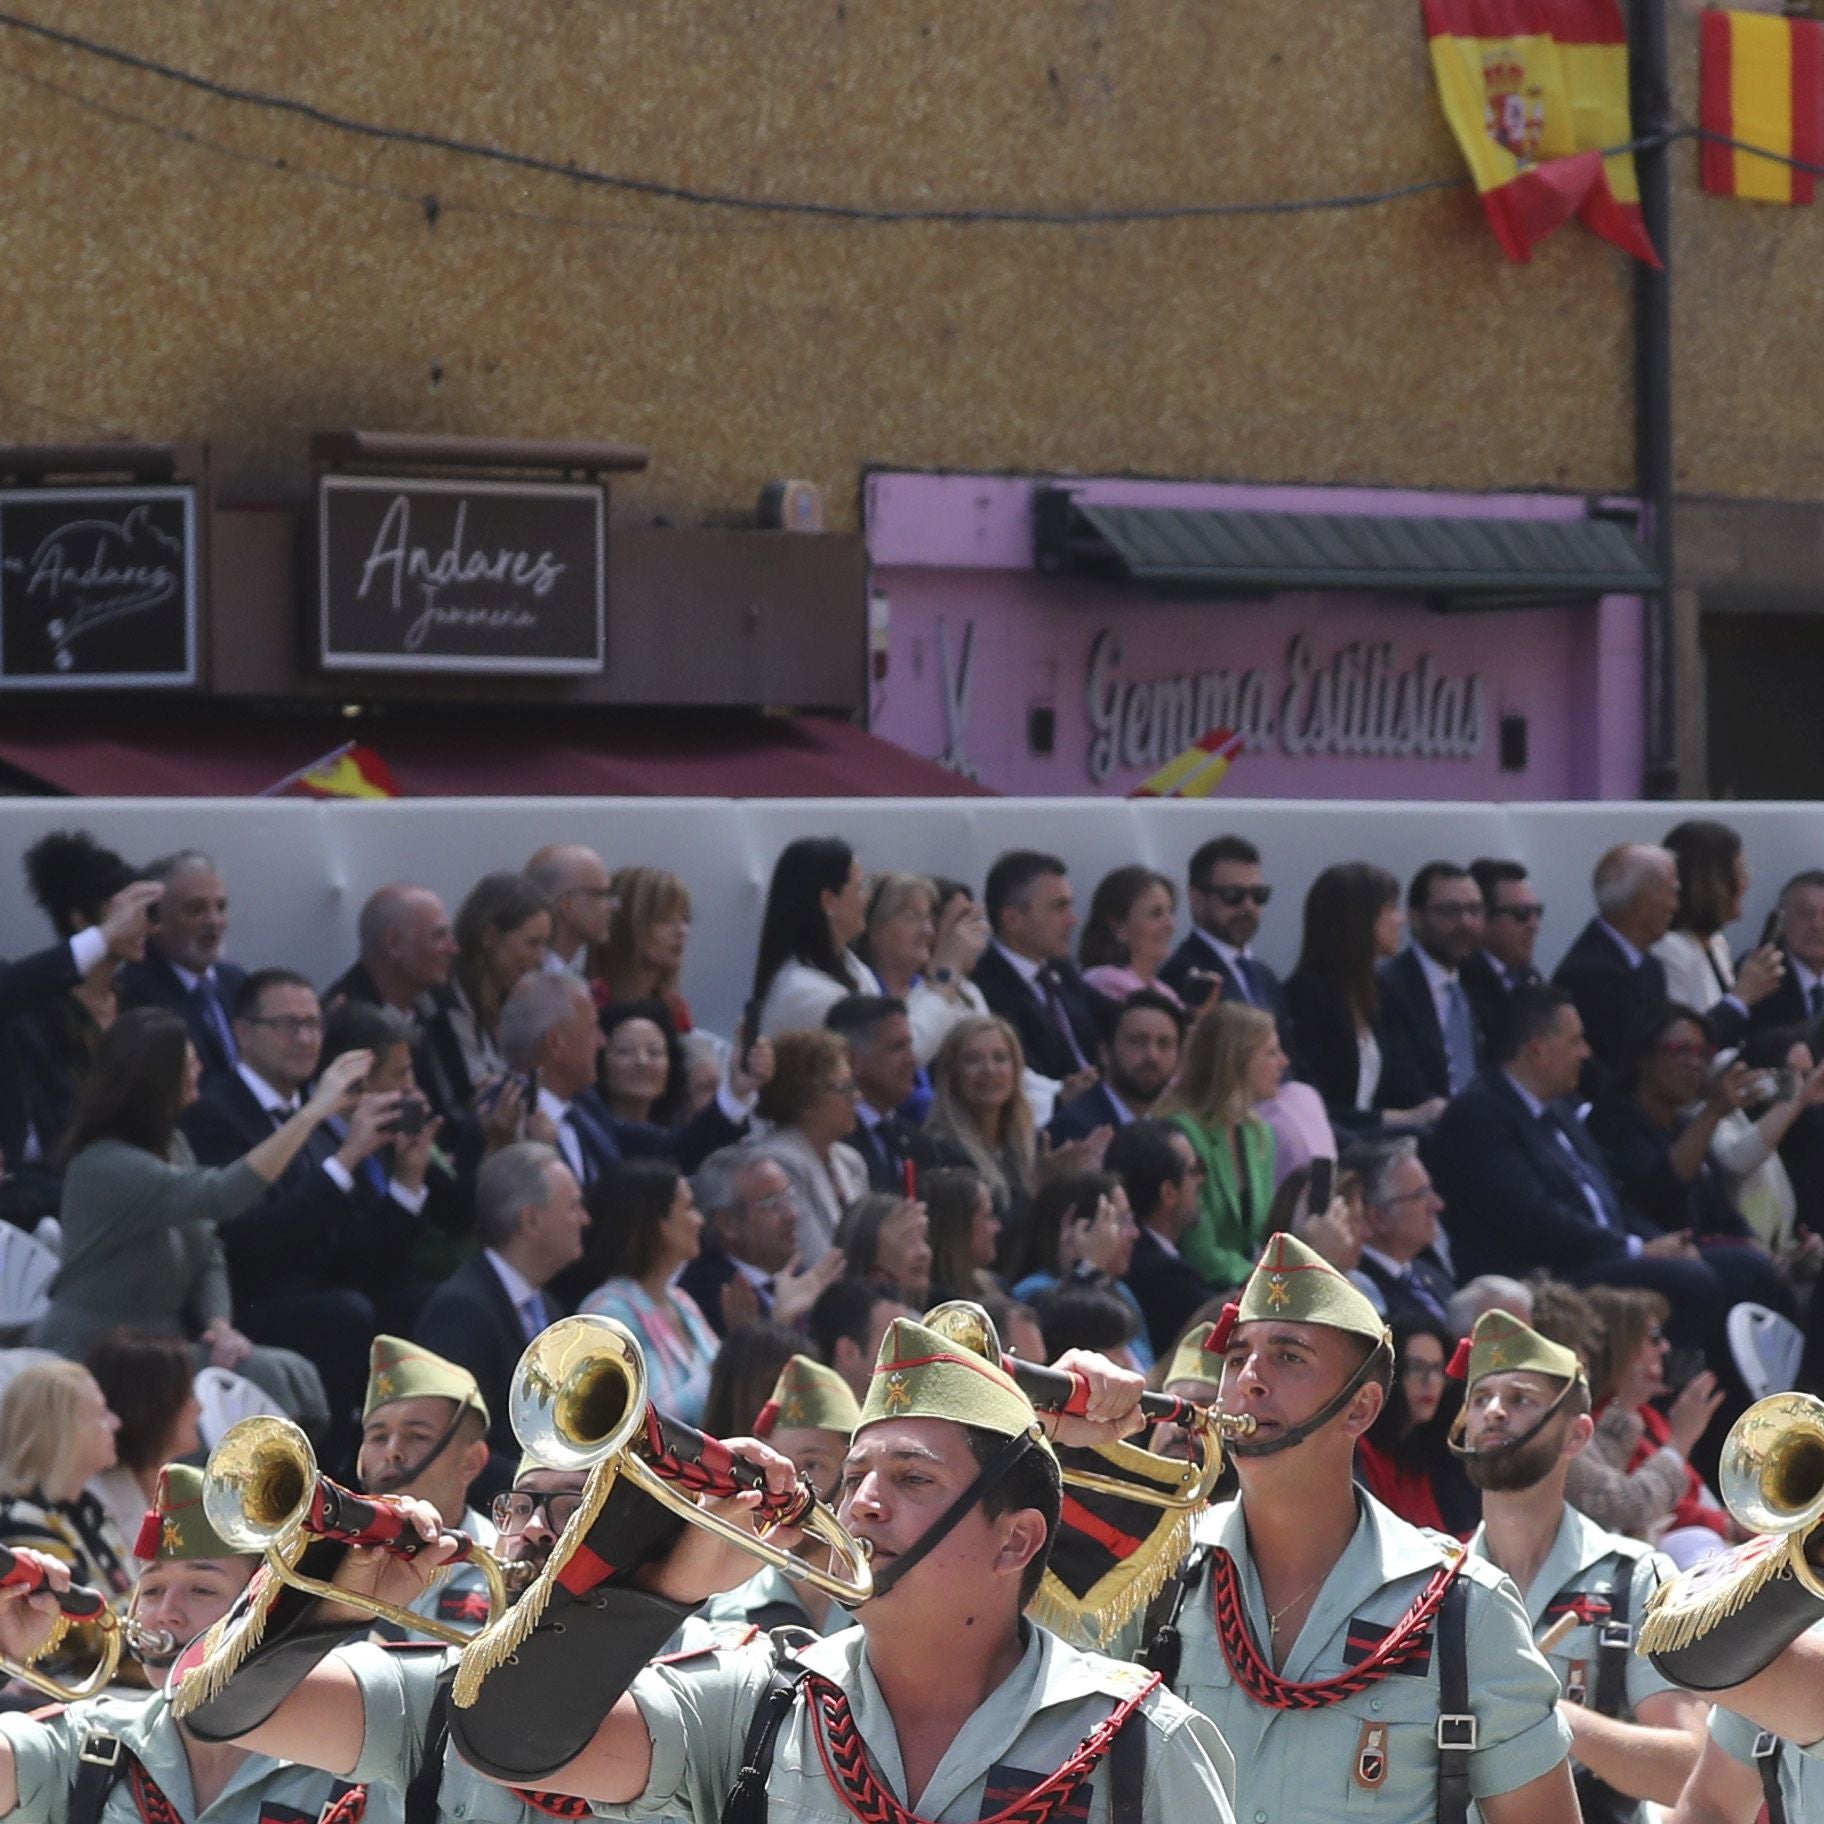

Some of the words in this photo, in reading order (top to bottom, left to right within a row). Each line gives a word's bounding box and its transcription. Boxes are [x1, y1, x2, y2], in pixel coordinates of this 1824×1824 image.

[357, 495, 568, 609] Andares
[1087, 628, 1276, 786] Gemma
[1280, 632, 1487, 758] Estilistas
